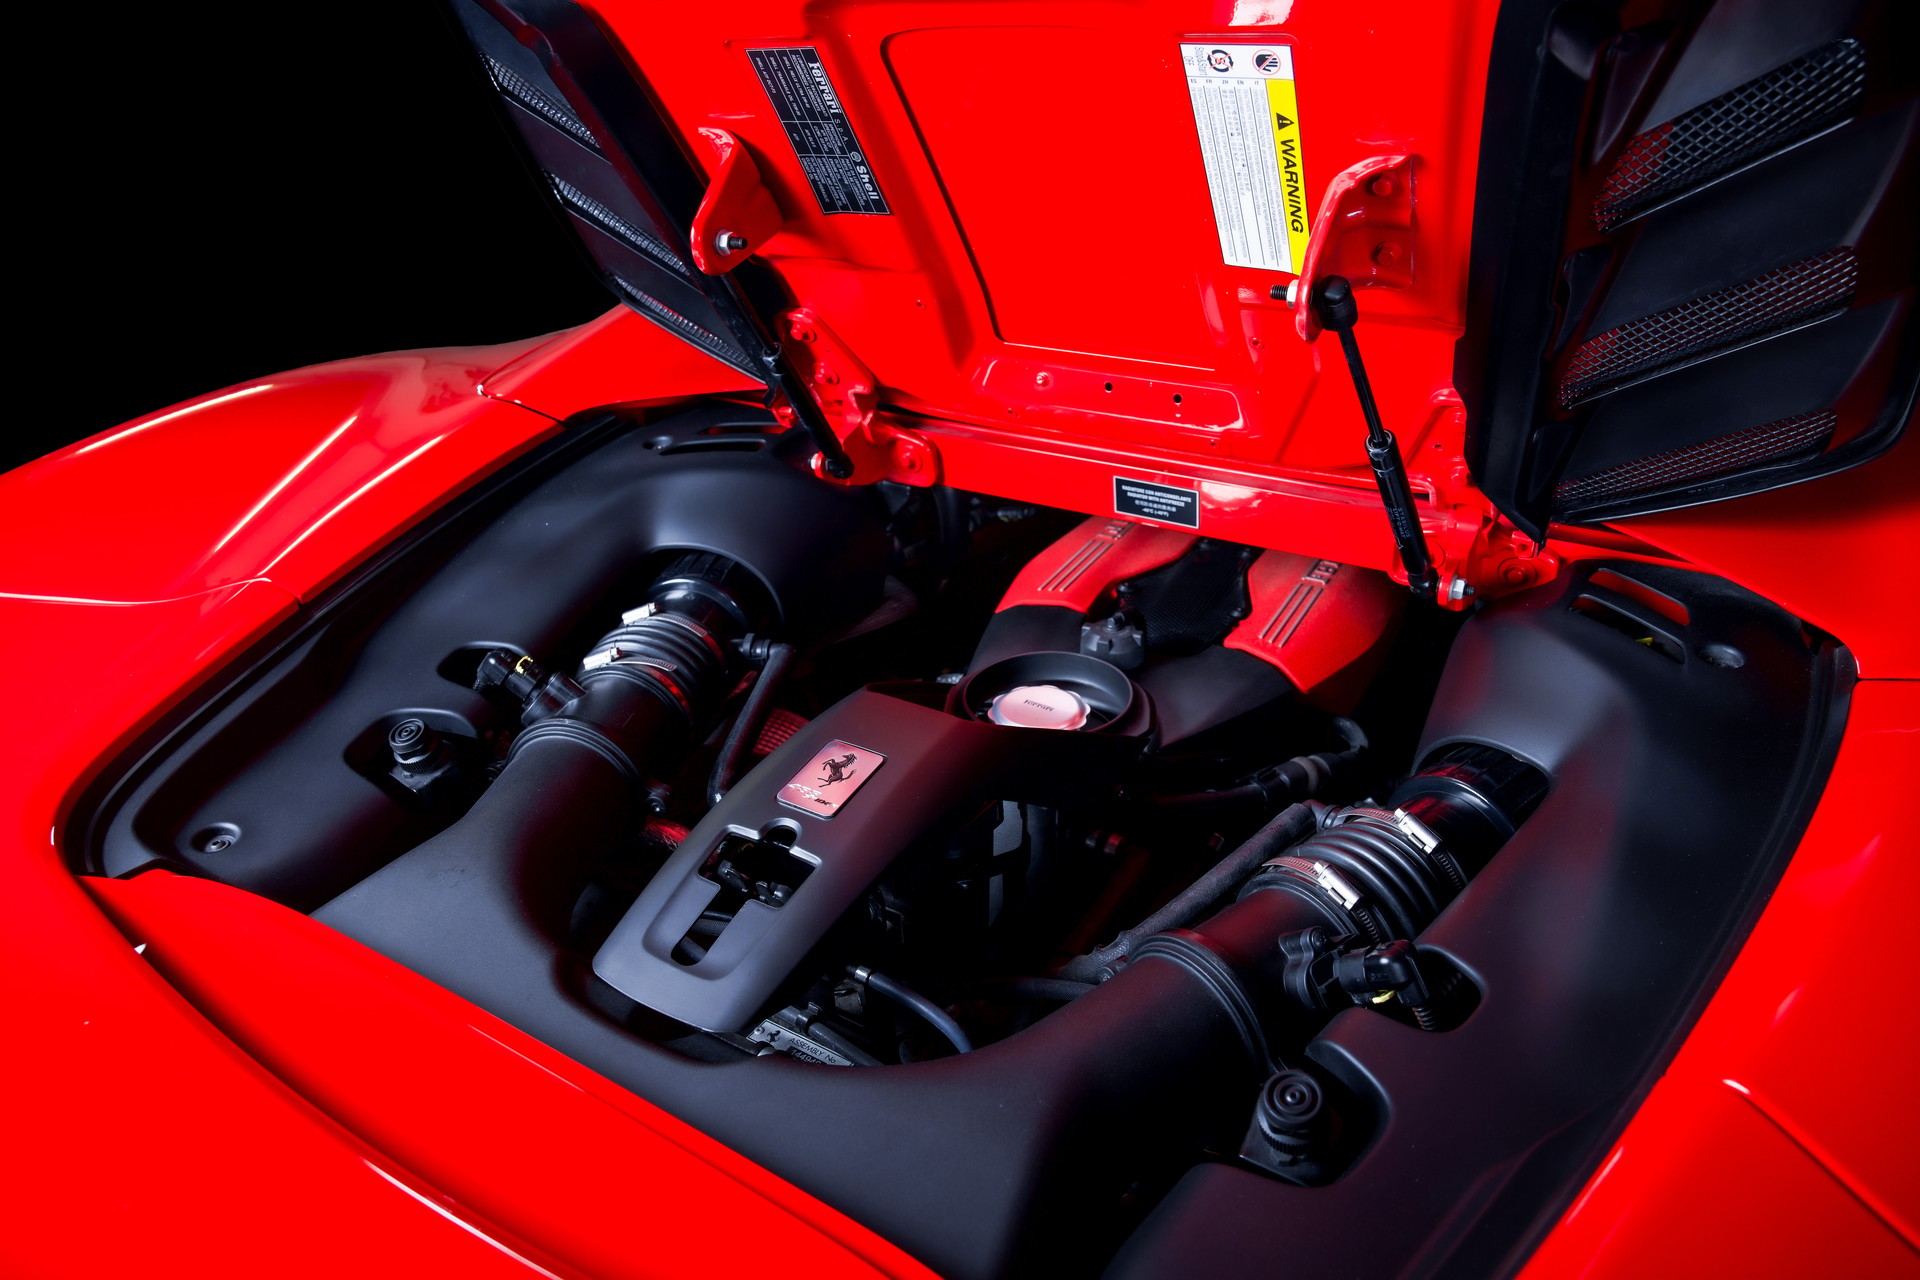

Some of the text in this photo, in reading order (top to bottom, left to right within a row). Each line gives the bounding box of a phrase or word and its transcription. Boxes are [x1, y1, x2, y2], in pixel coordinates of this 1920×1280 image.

[807, 62, 841, 113] Ferrari
[855, 165, 879, 199] Shell
[1280, 138, 1304, 234] WARNING
[1024, 699, 1055, 712] Ferrari
[790, 1037, 825, 1057] ASSEMBLY
